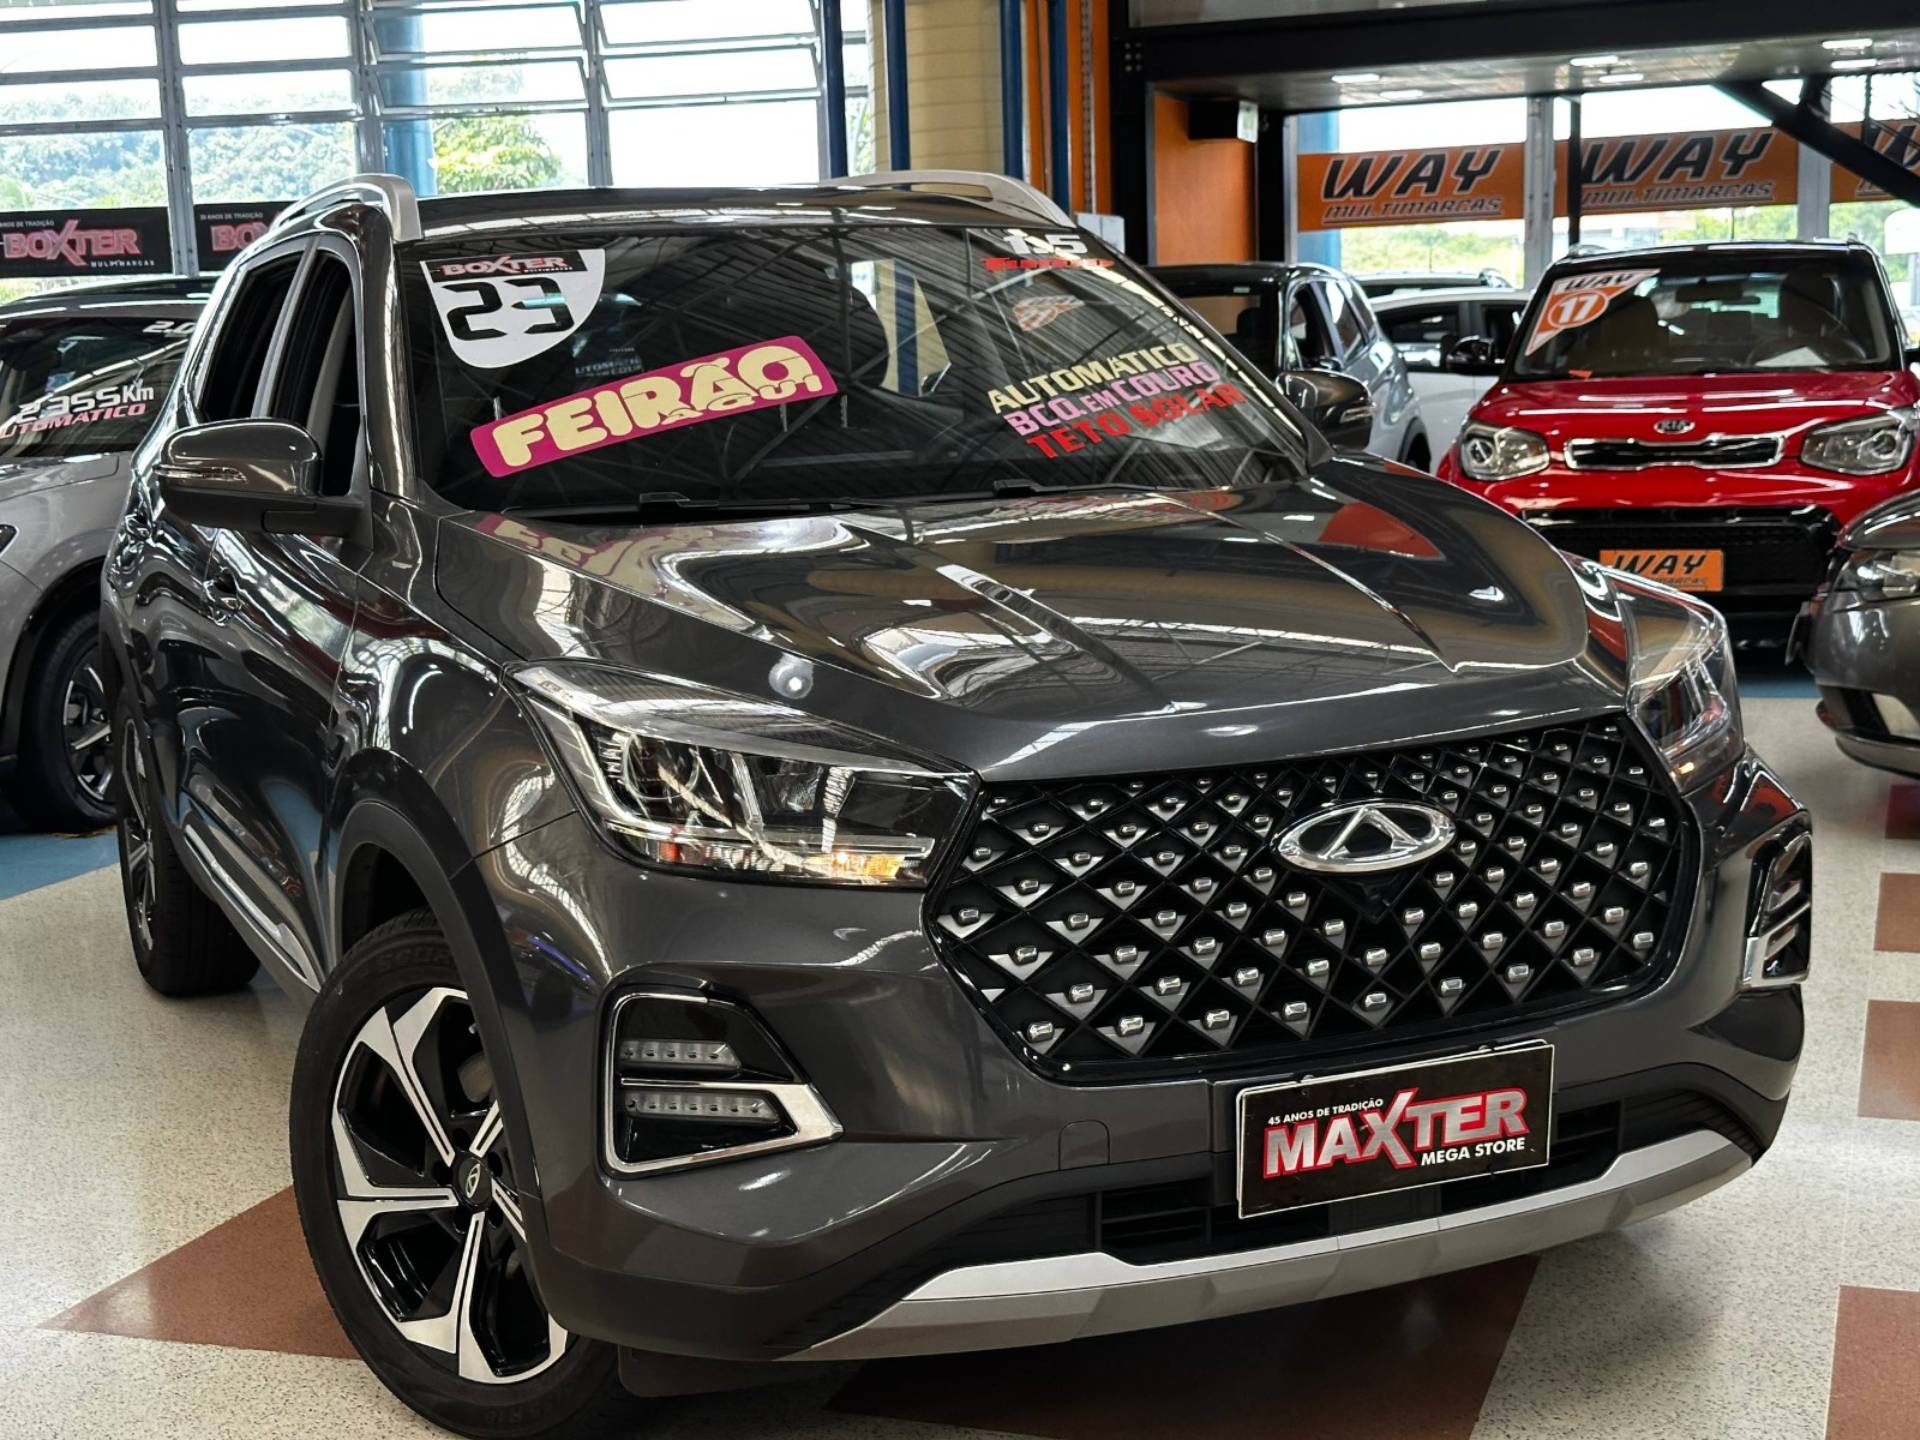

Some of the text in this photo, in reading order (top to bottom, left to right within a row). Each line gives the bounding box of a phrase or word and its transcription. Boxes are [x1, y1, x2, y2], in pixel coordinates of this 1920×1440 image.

[1323, 150, 1502, 200] WAY
[1583, 133, 1773, 183] WAY
[3, 219, 141, 267] BOXTER
[439, 255, 569, 277] BOXTER
[441, 276, 575, 341] 23
[1558, 294, 1599, 324] 17
[492, 345, 814, 467] FEIRÃO
[1079, 390, 1121, 412] EM
[1110, 361, 1221, 401] COURO
[1025, 382, 1248, 459] TETO SOLAR
[1613, 554, 1707, 575] WAY
[1263, 1087, 1530, 1179] MAXTER
[1267, 1097, 1384, 1126] 45 ANOS DE TRADIÇÃO
[1421, 1137, 1526, 1166] MEGA STORE
